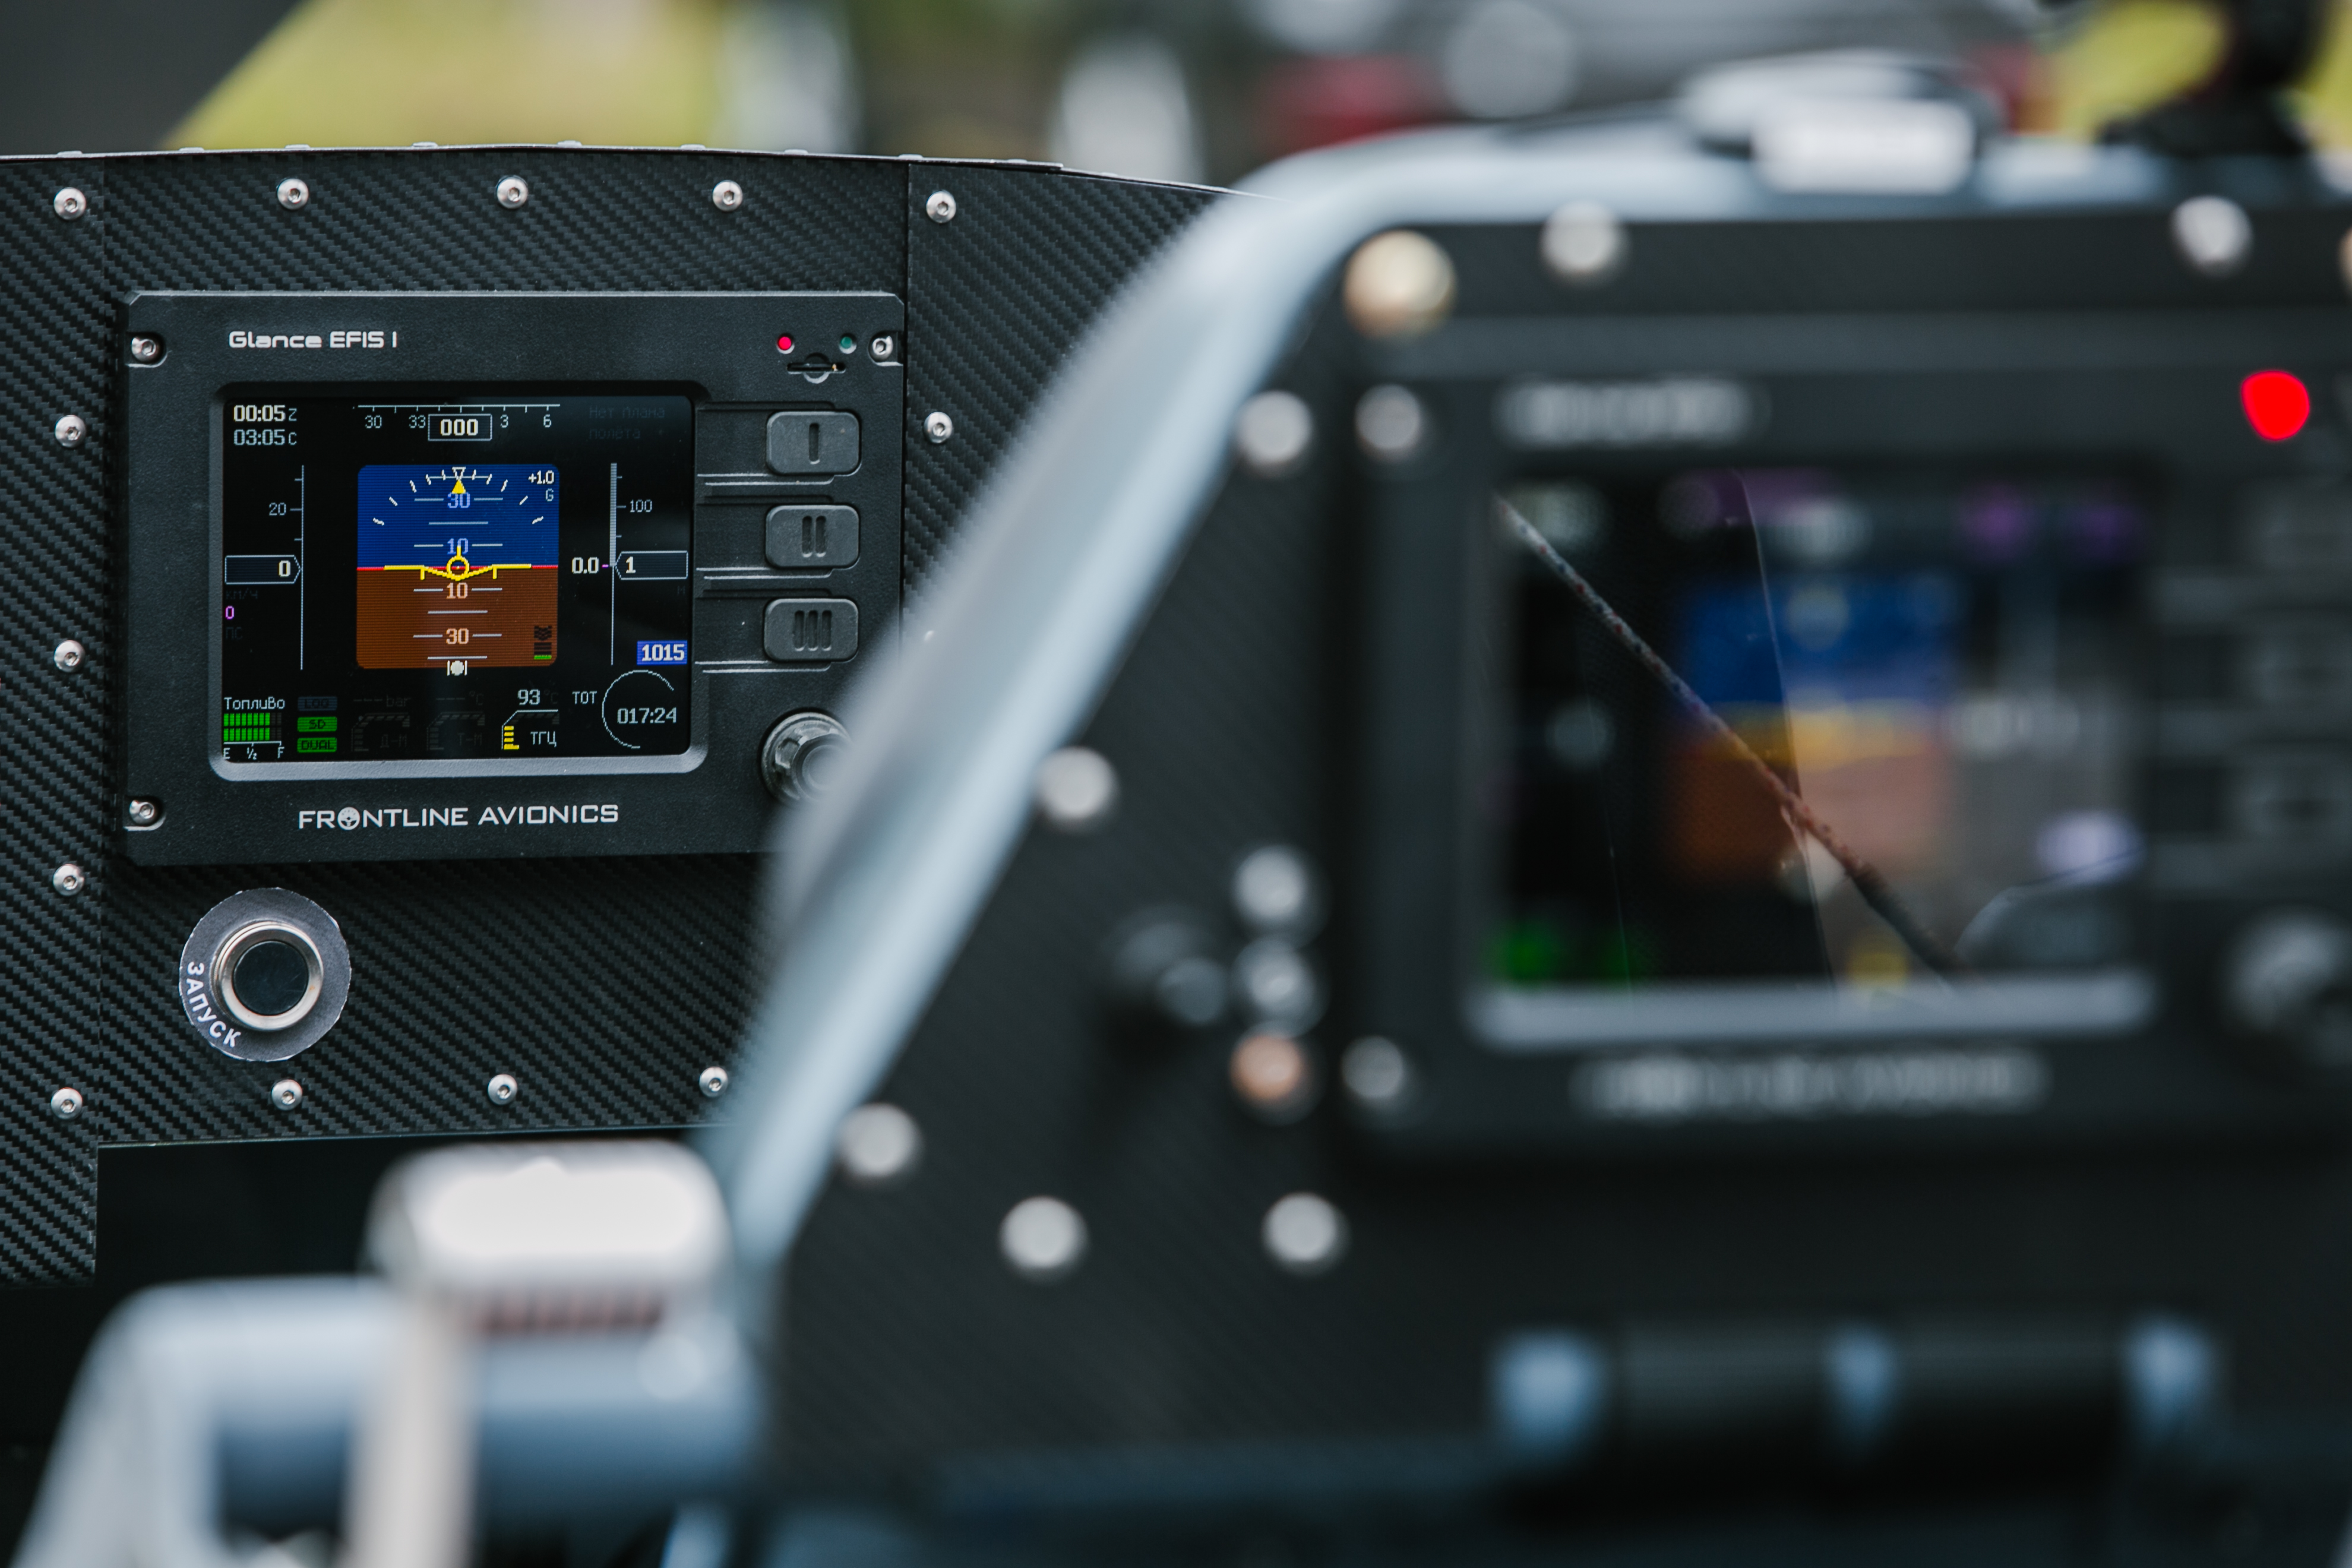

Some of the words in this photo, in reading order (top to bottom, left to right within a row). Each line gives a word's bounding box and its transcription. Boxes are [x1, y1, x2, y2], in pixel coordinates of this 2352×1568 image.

[229, 331, 323, 348] Glance
[329, 331, 384, 348] EFIS
[233, 404, 286, 422] 00:05
[288, 407, 297, 422] Z
[365, 415, 382, 429] 30
[409, 415, 426, 429] 33
[440, 418, 479, 436] 000
[500, 414, 509, 428] 3
[543, 413, 552, 428] 6
[233, 429, 285, 445] 03:05
[528, 470, 555, 485] +1.0
[447, 492, 471, 509] 30
[545, 488, 554, 502] G
[268, 502, 287, 516] 20
[630, 499, 653, 513] 100
[446, 538, 469, 555] 10
[279, 560, 291, 577] 0
[571, 557, 599, 574] 0.0
[625, 556, 636, 574] 1
[446, 582, 468, 599] 10
[225, 605, 235, 620] 0
[445, 628, 469, 644] 30
[641, 643, 685, 661] 1015
[517, 689, 540, 705] 93
[617, 707, 677, 724] 017:24
[308, 719, 327, 730] SD
[223, 747, 230, 760] E
[277, 745, 285, 758] F
[300, 739, 335, 752] DUAL
[298, 807, 469, 830] FRONTLINE
[478, 804, 618, 826] AVIONICS
[185, 960, 242, 1049] ЗАПУСК
